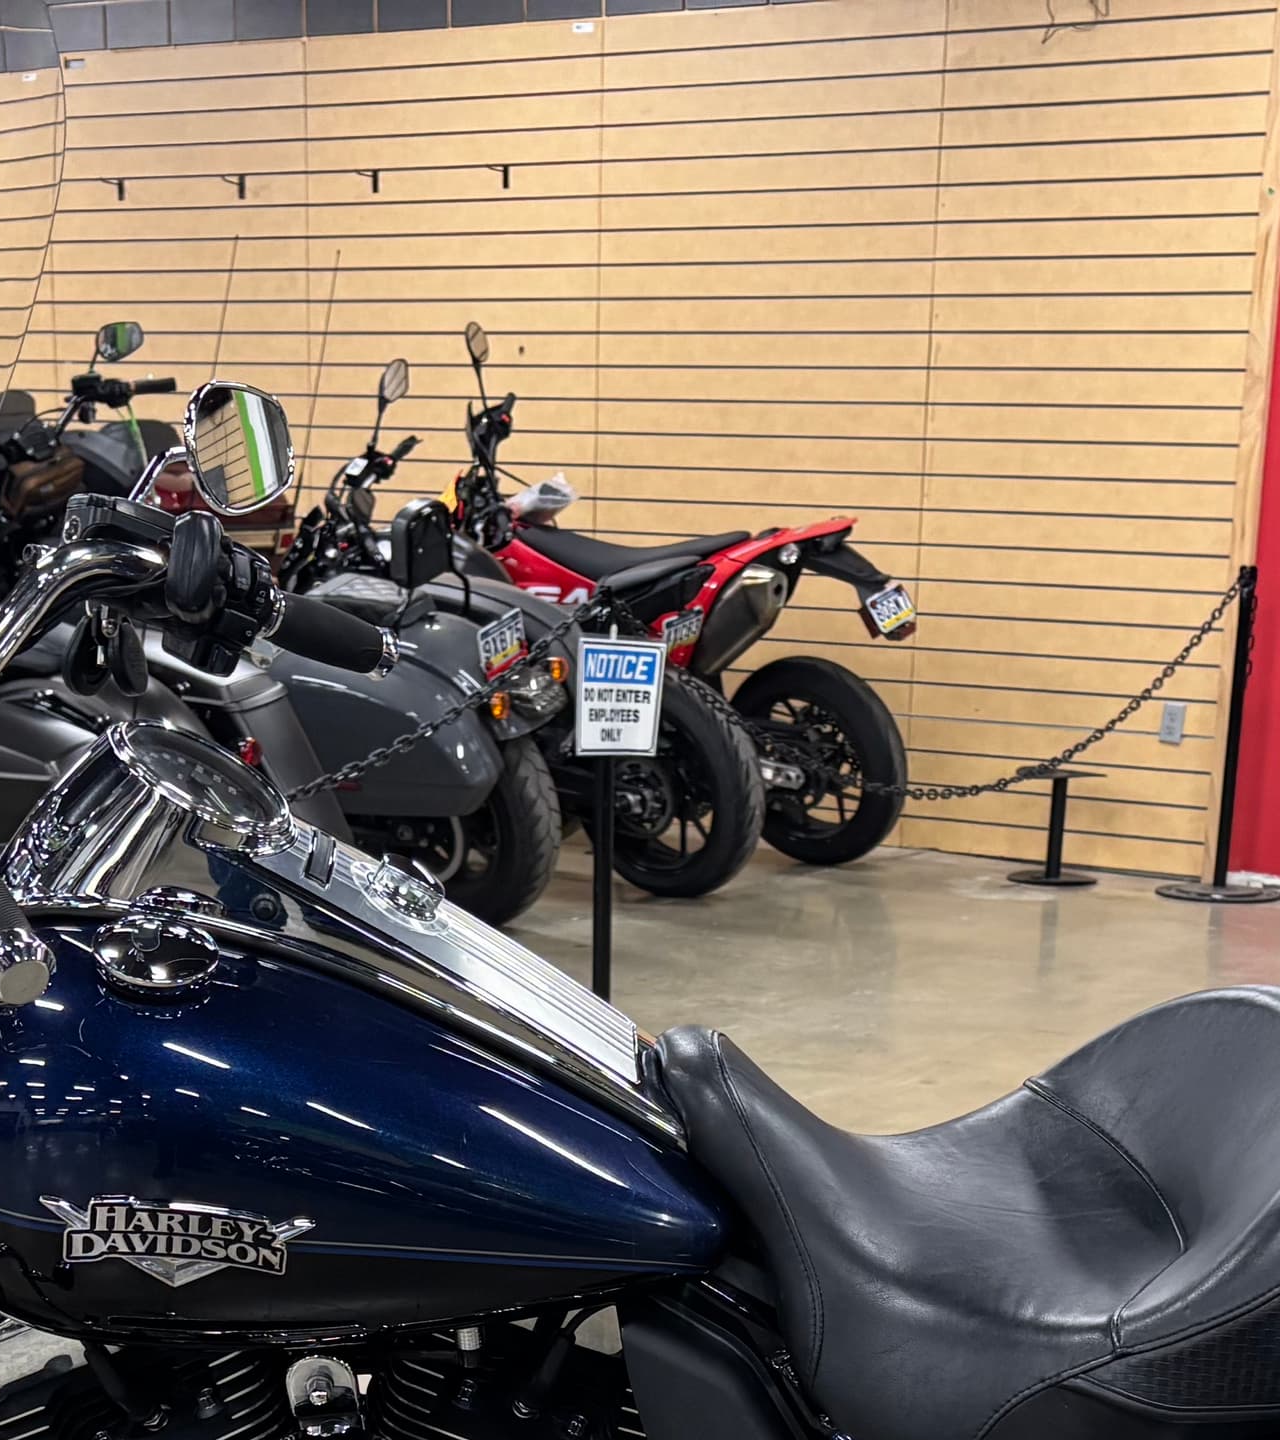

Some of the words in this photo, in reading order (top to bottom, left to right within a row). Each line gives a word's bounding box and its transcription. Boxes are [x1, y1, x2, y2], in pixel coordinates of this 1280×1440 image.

[585, 653, 654, 680] NOTICE
[584, 688, 596, 701] DO
[597, 688, 614, 702] NOT
[615, 689, 651, 704] ENTER
[589, 708, 640, 723] EMPLOYEES
[601, 728, 623, 742] ONLY
[95, 1206, 276, 1243] HARLEY-
[71, 1233, 282, 1270] DAVIDSON
